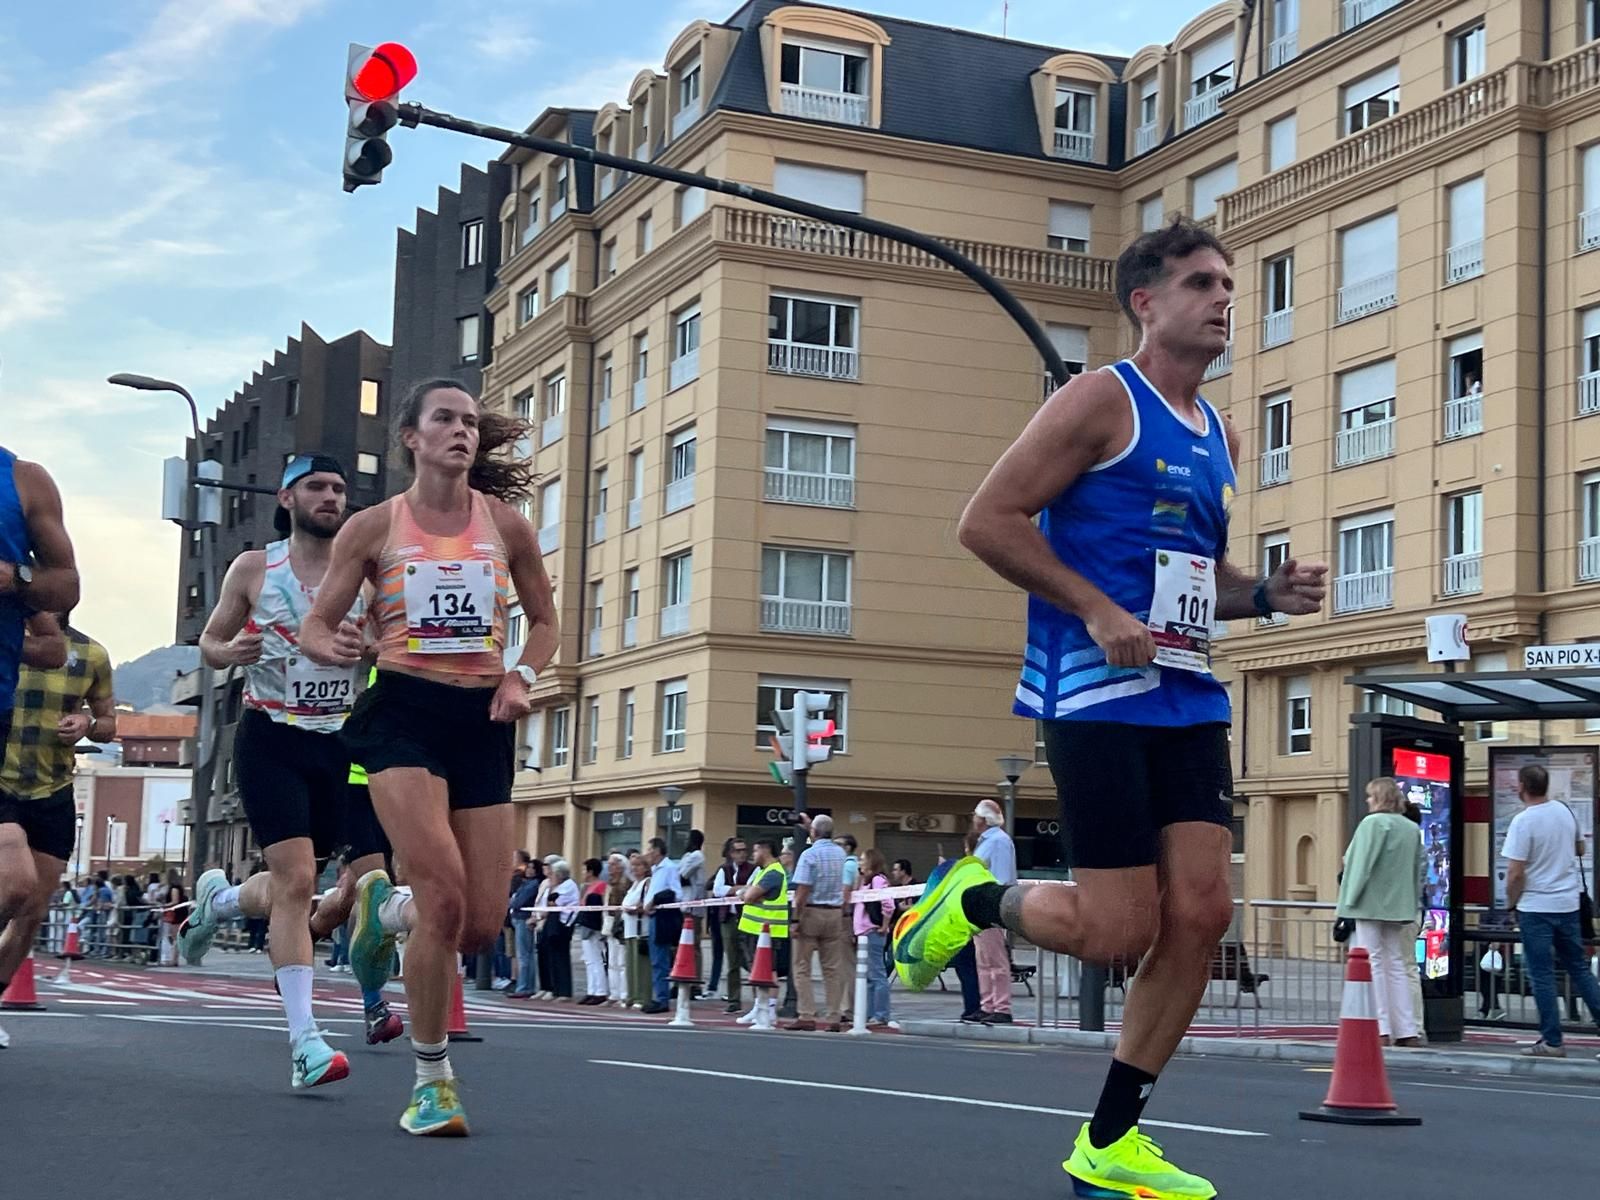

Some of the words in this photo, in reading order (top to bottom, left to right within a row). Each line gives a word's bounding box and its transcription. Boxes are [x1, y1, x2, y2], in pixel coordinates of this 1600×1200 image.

[1167, 465, 1191, 477] ence
[428, 592, 476, 616] 134
[1177, 593, 1209, 626] 101
[1526, 650, 1553, 665] SAN
[1558, 649, 1580, 664] PIO
[1584, 648, 1600, 663] X-
[291, 679, 350, 699] 12073
